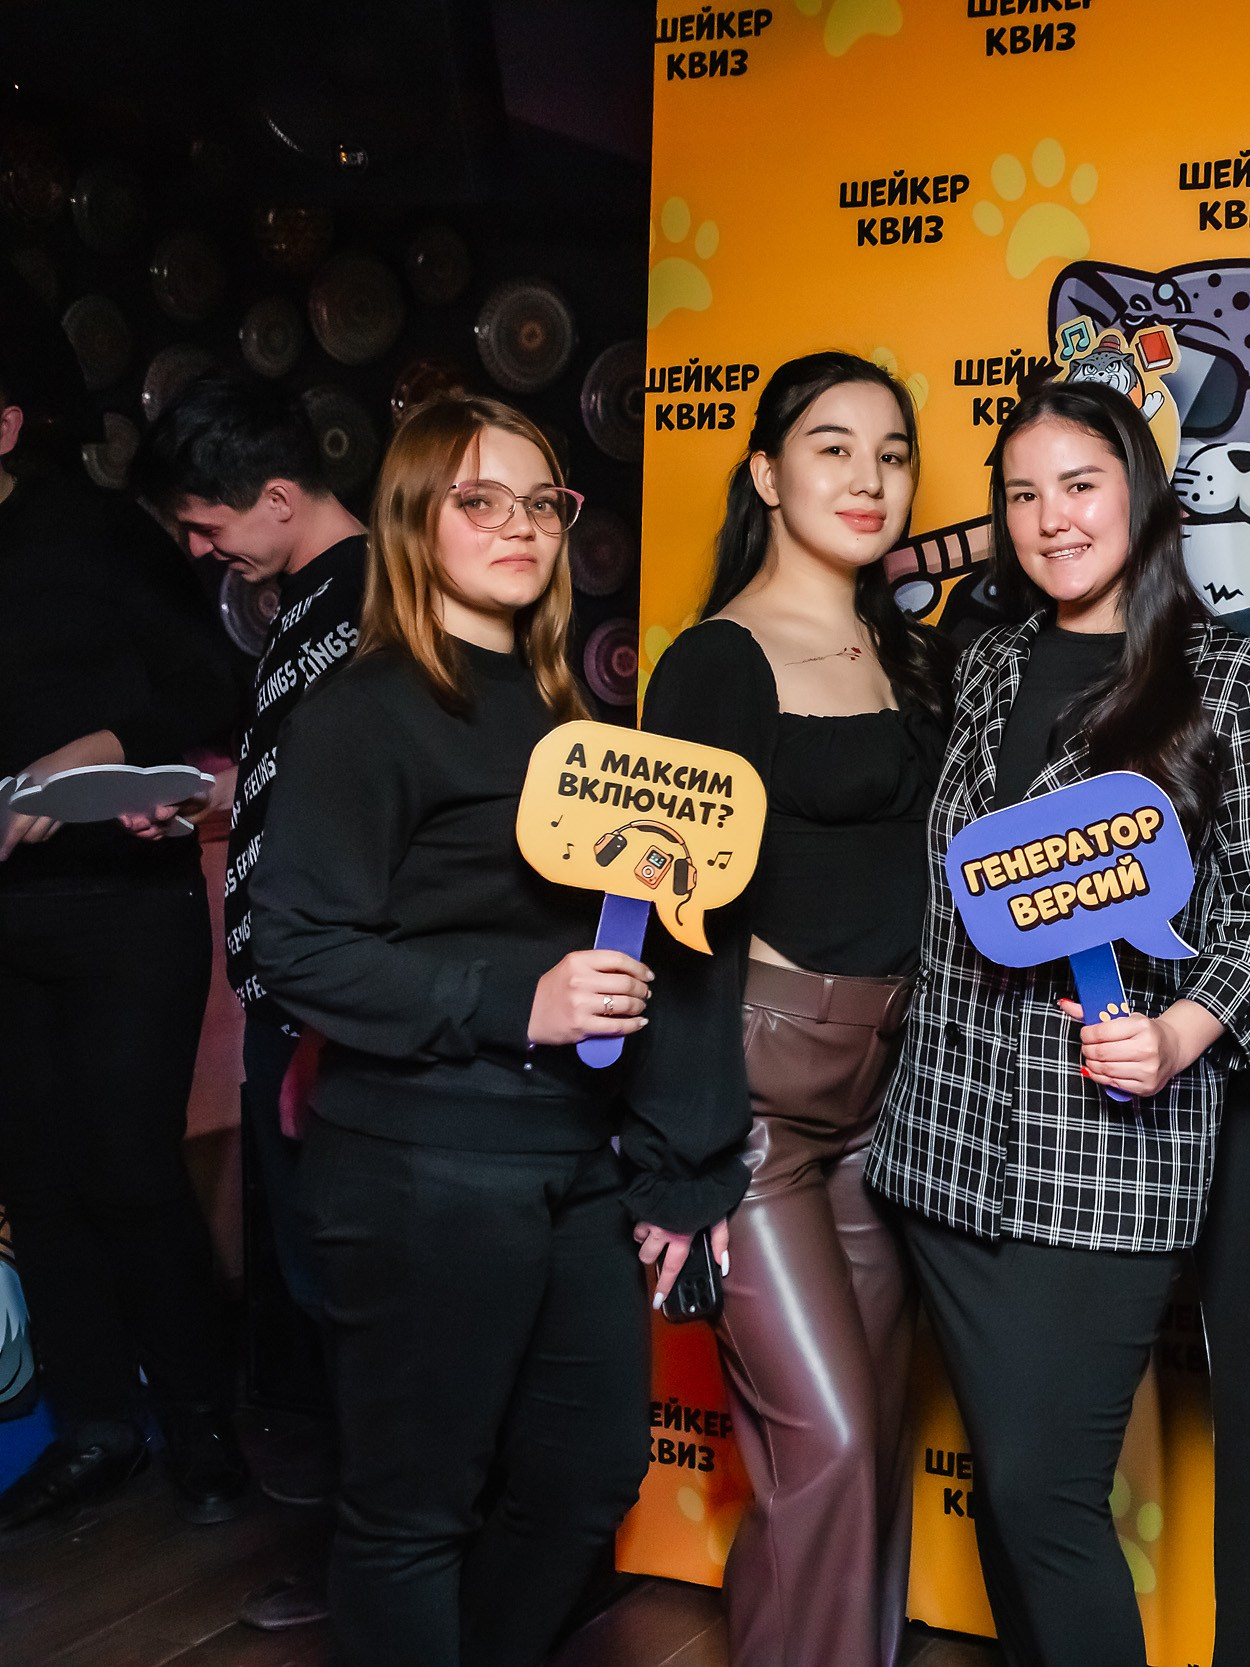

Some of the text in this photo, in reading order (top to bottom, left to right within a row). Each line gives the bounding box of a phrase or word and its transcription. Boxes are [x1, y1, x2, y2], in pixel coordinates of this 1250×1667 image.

[655, 6, 773, 43] ШЕЙКЕР
[986, 22, 1076, 56] КВИЗ
[667, 49, 749, 80] КВИЗ
[839, 169, 970, 208] ШЕЙКЕР
[857, 215, 944, 247] КВИЗ
[645, 358, 760, 393] ШЕЙКЕР
[954, 348, 1049, 386] ШЕЙ
[655, 402, 736, 431] КВИЗ
[973, 397, 1016, 426] КВ
[565, 742, 733, 798] А МАКСИМ
[557, 772, 734, 828] ВКЛЮЧАТ?
[962, 806, 1163, 896] ГЕНЕРАТОР
[1008, 854, 1150, 931] ВЕРСИЙ
[649, 1397, 733, 1438] ЕЙКЕР
